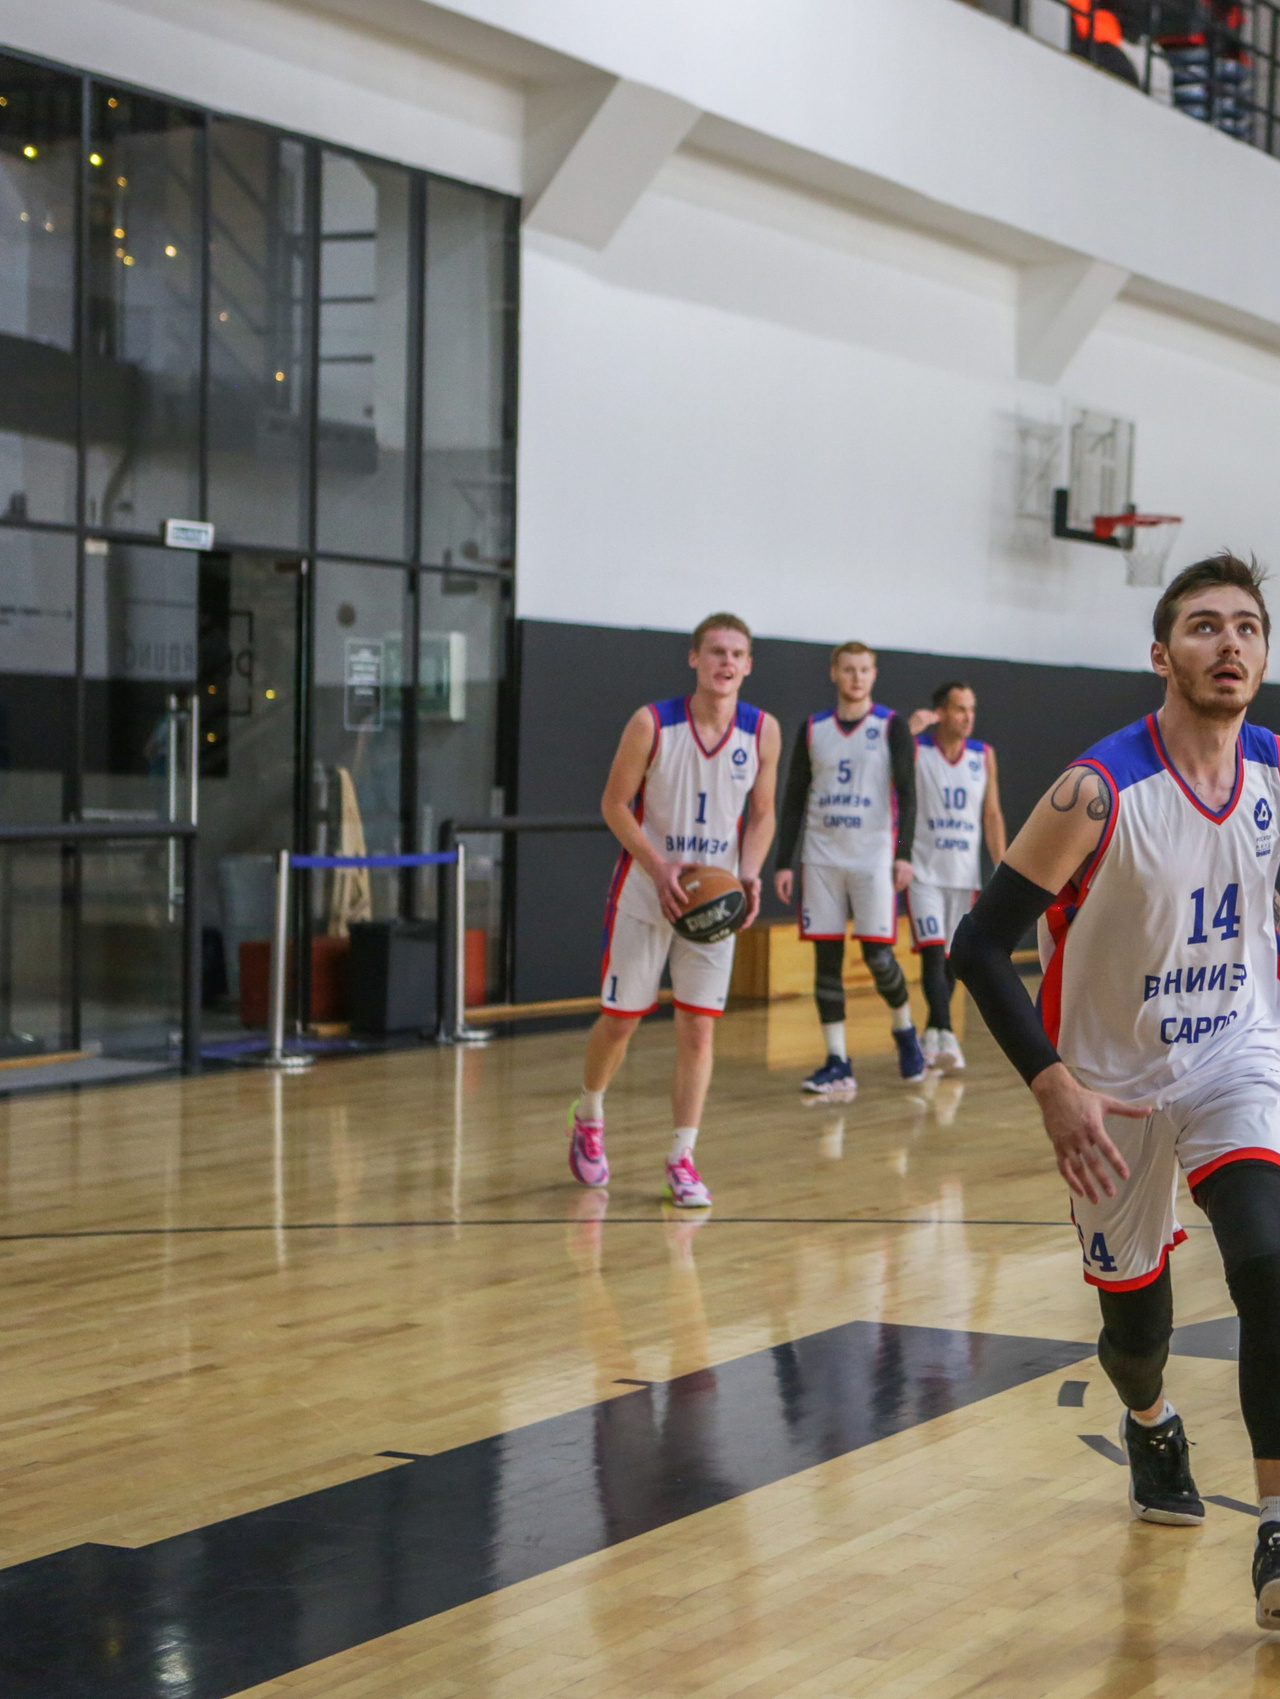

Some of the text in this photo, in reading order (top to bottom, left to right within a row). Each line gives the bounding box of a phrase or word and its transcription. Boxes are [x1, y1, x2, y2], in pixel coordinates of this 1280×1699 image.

[837, 759, 851, 784] 5
[695, 792, 706, 824] 1
[943, 787, 966, 810] 10
[917, 916, 938, 937] 10
[1187, 883, 1241, 945] 14
[607, 975, 618, 1002] 1
[1144, 963, 1247, 1002] ВНИИЭ
